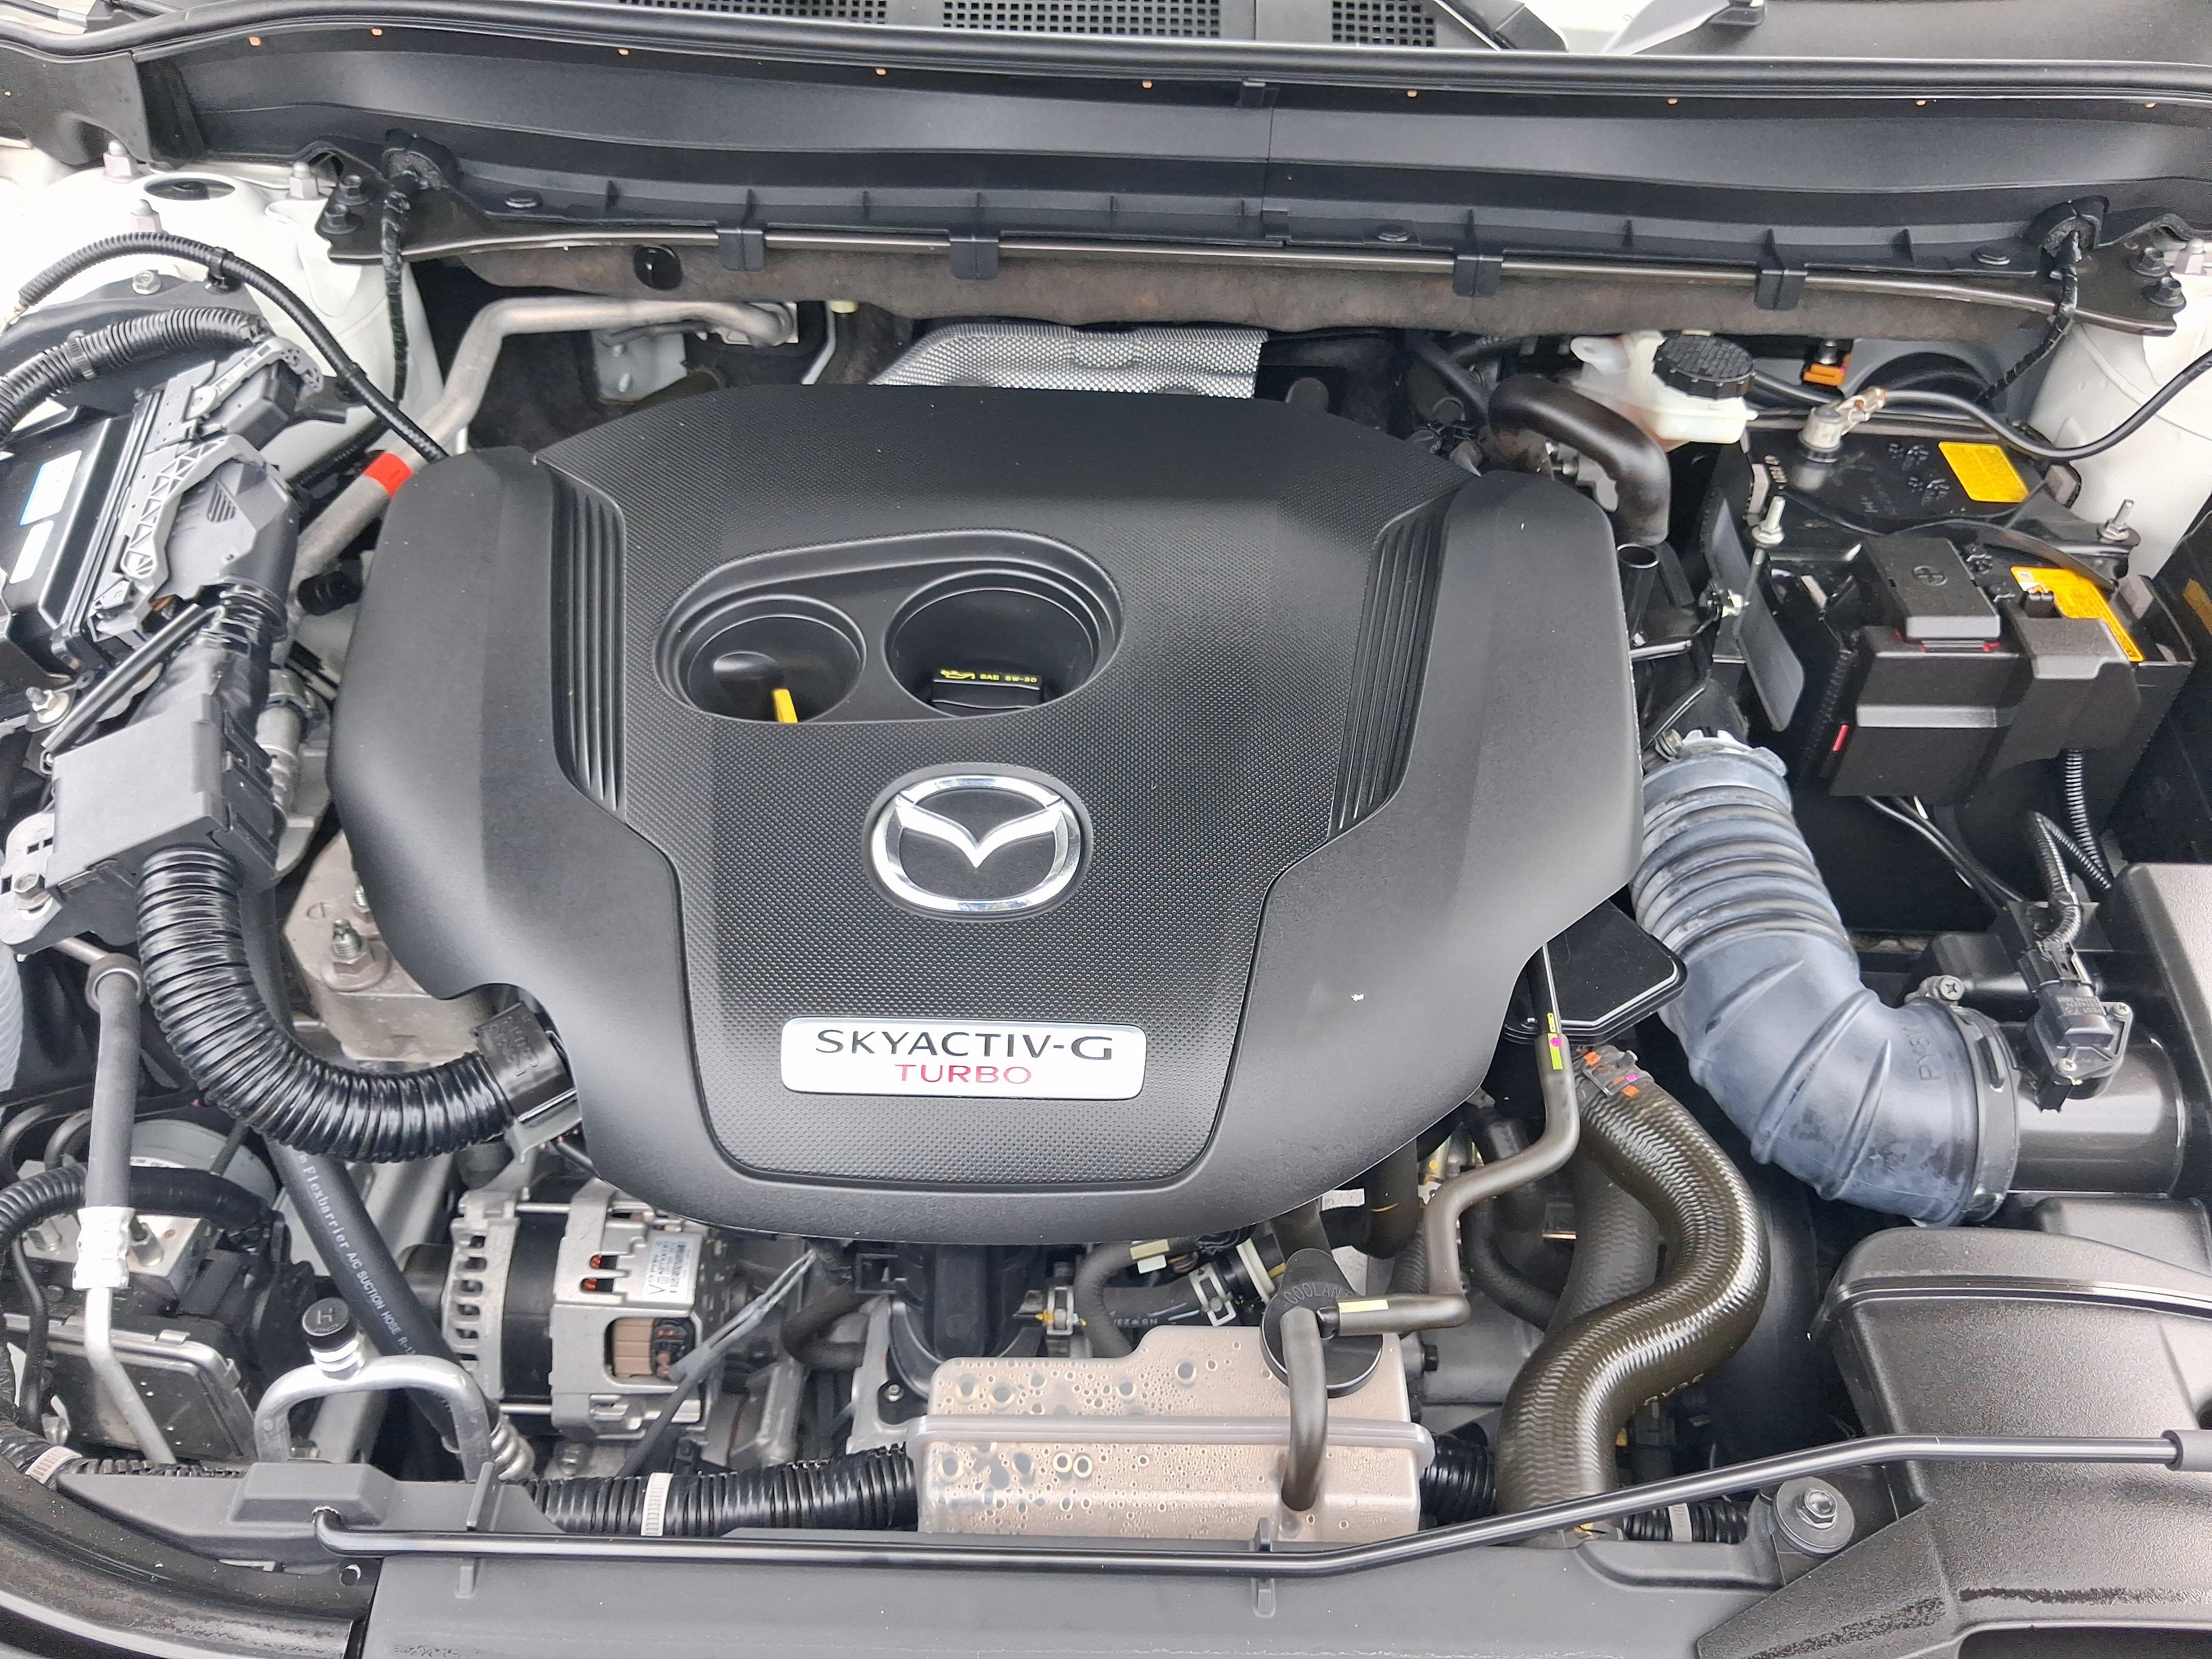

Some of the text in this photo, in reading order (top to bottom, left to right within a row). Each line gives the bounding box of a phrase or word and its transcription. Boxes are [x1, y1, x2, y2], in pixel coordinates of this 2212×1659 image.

[815, 1029, 1113, 1060] SKYACTIV-G
[894, 1064, 1032, 1084] TURBO
[303, 1166, 351, 1249] Flexbarrier
[346, 1251, 363, 1269] A/C
[357, 1271, 385, 1310] SUCTION
[381, 1310, 402, 1335] HOSE
[317, 1308, 333, 1324] H
